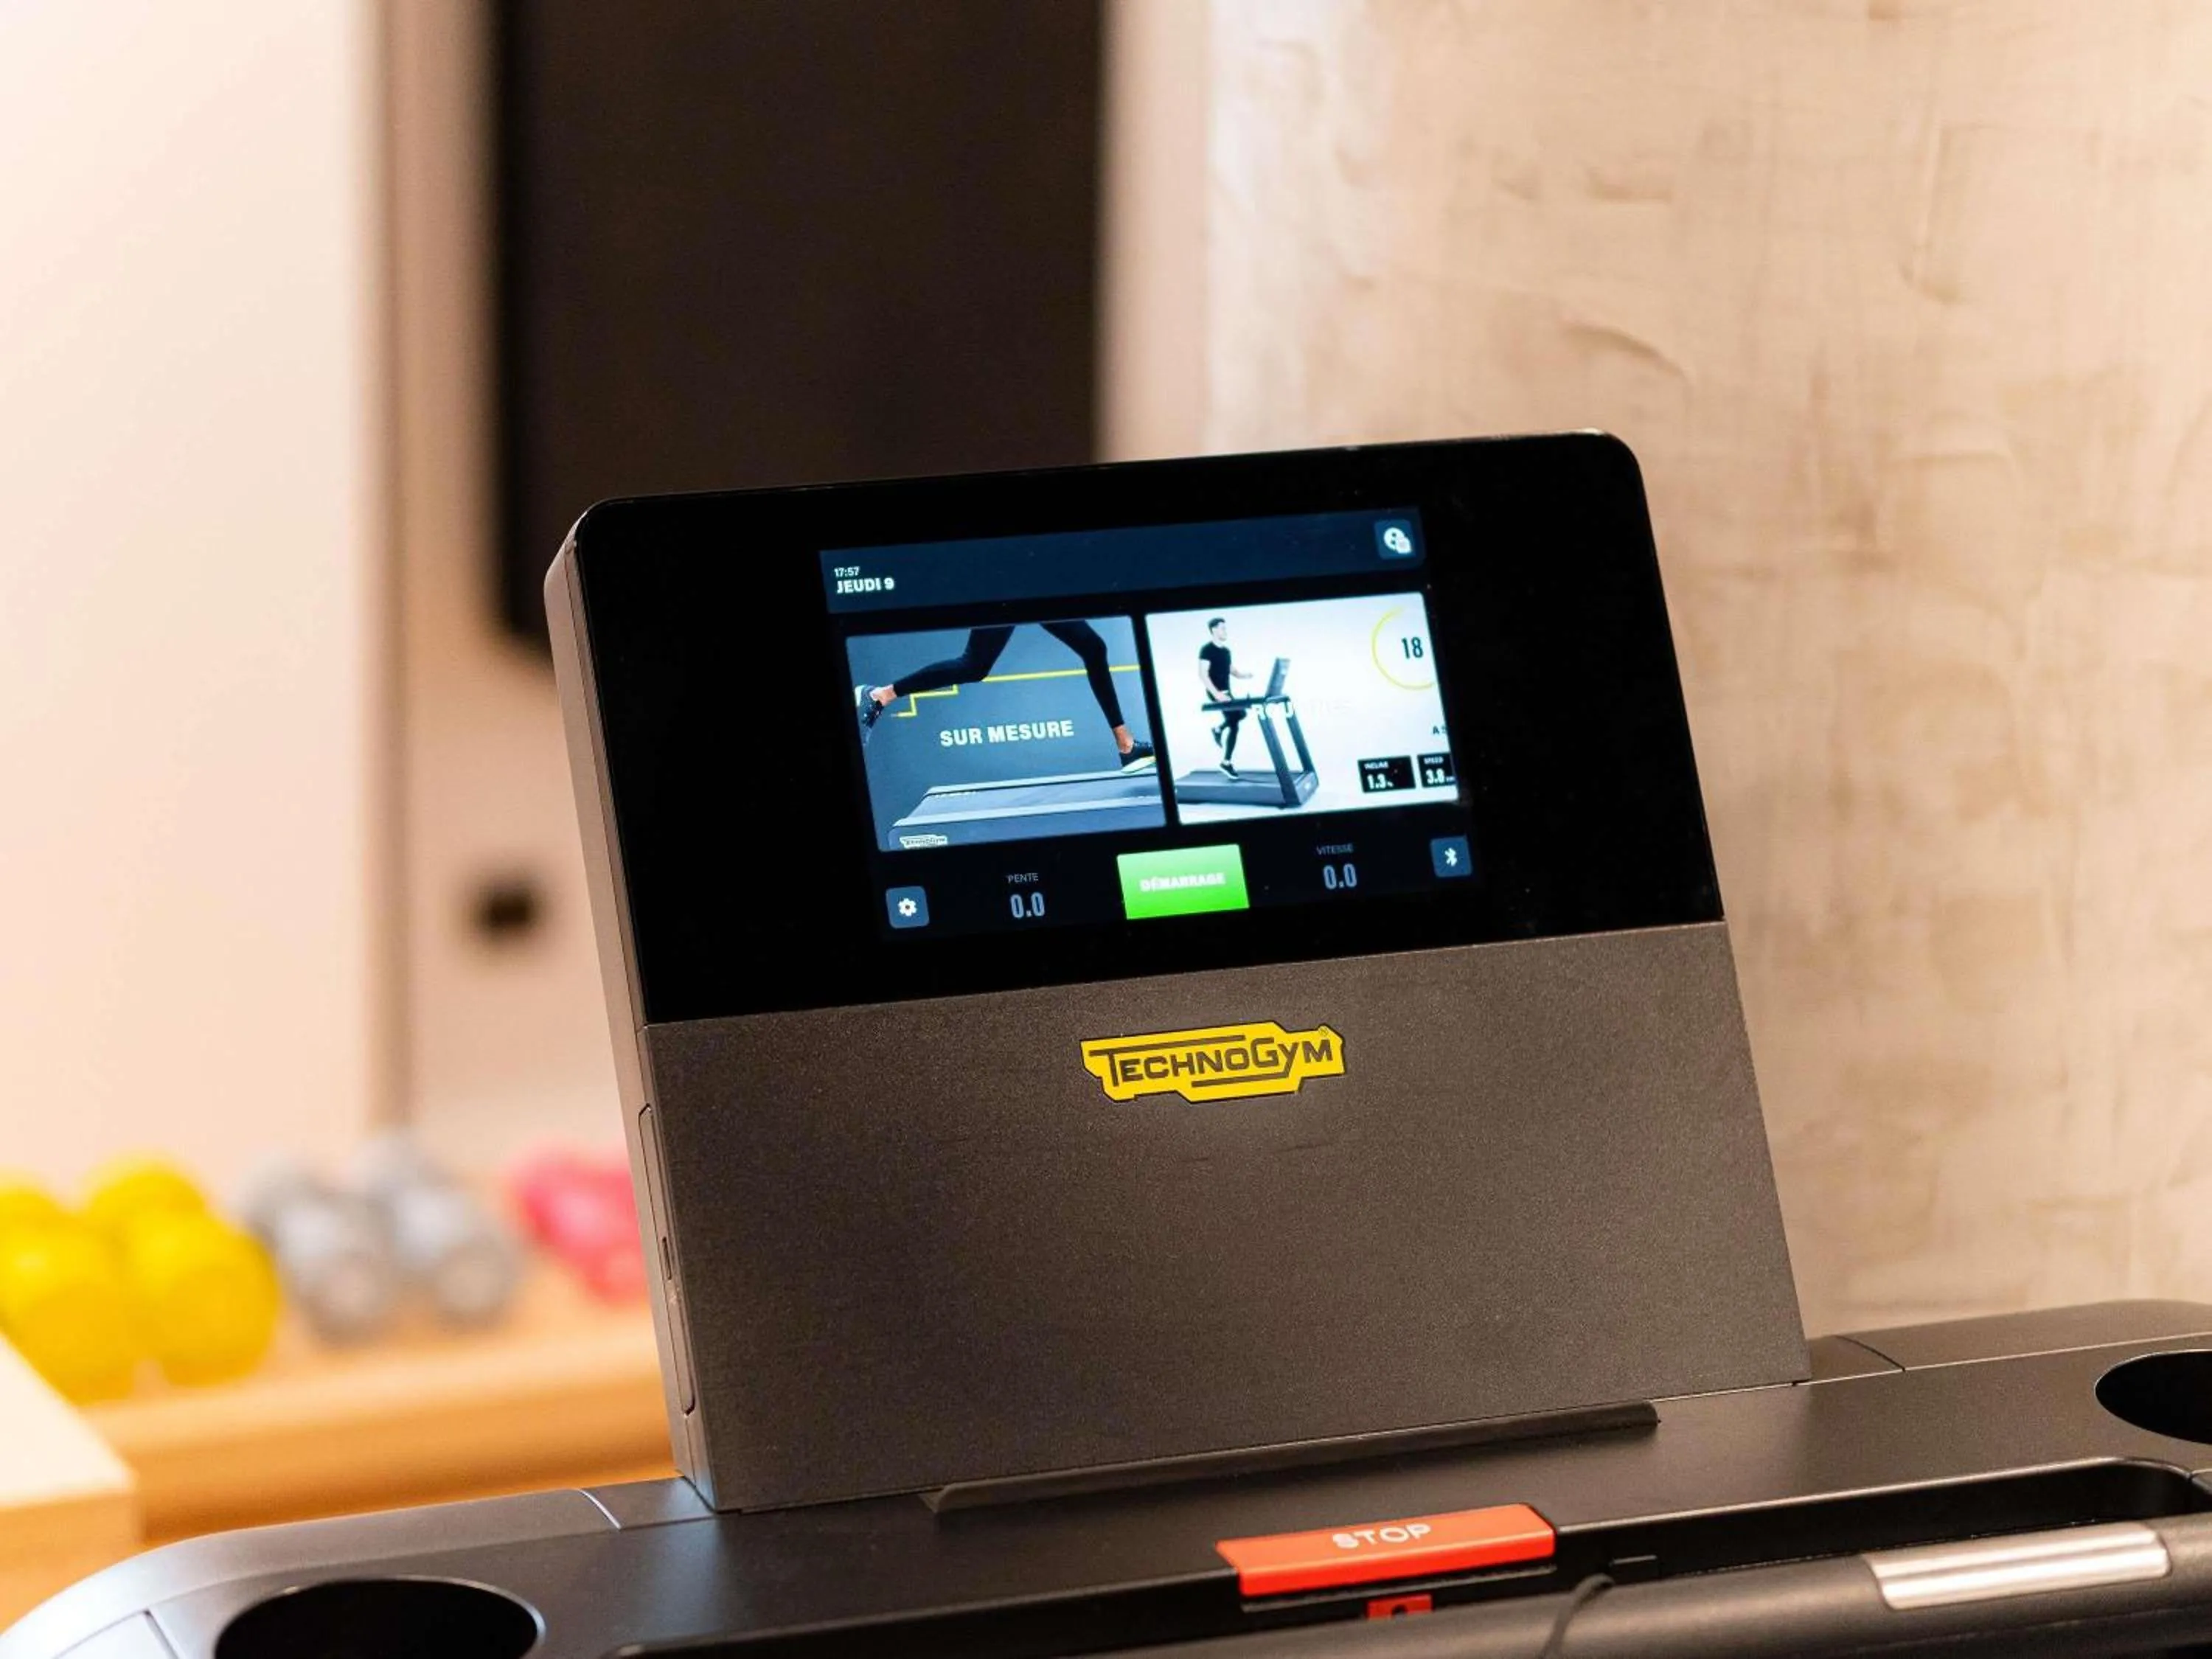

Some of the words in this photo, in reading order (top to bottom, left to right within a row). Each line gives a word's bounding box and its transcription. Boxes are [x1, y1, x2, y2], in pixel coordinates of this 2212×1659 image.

[834, 566, 860, 577] 17:57
[837, 577, 882, 594] JEUDI
[884, 577, 895, 591] 9
[1400, 636, 1424, 659] 18
[939, 727, 983, 747] SUR
[987, 720, 1074, 743] MESURE
[1316, 844, 1354, 855] VITESSE
[1007, 872, 1039, 883] PENTE
[1324, 863, 1357, 890] 0.0
[1010, 891, 1046, 919] 0.0
[1332, 1523, 1431, 1548] STOP
